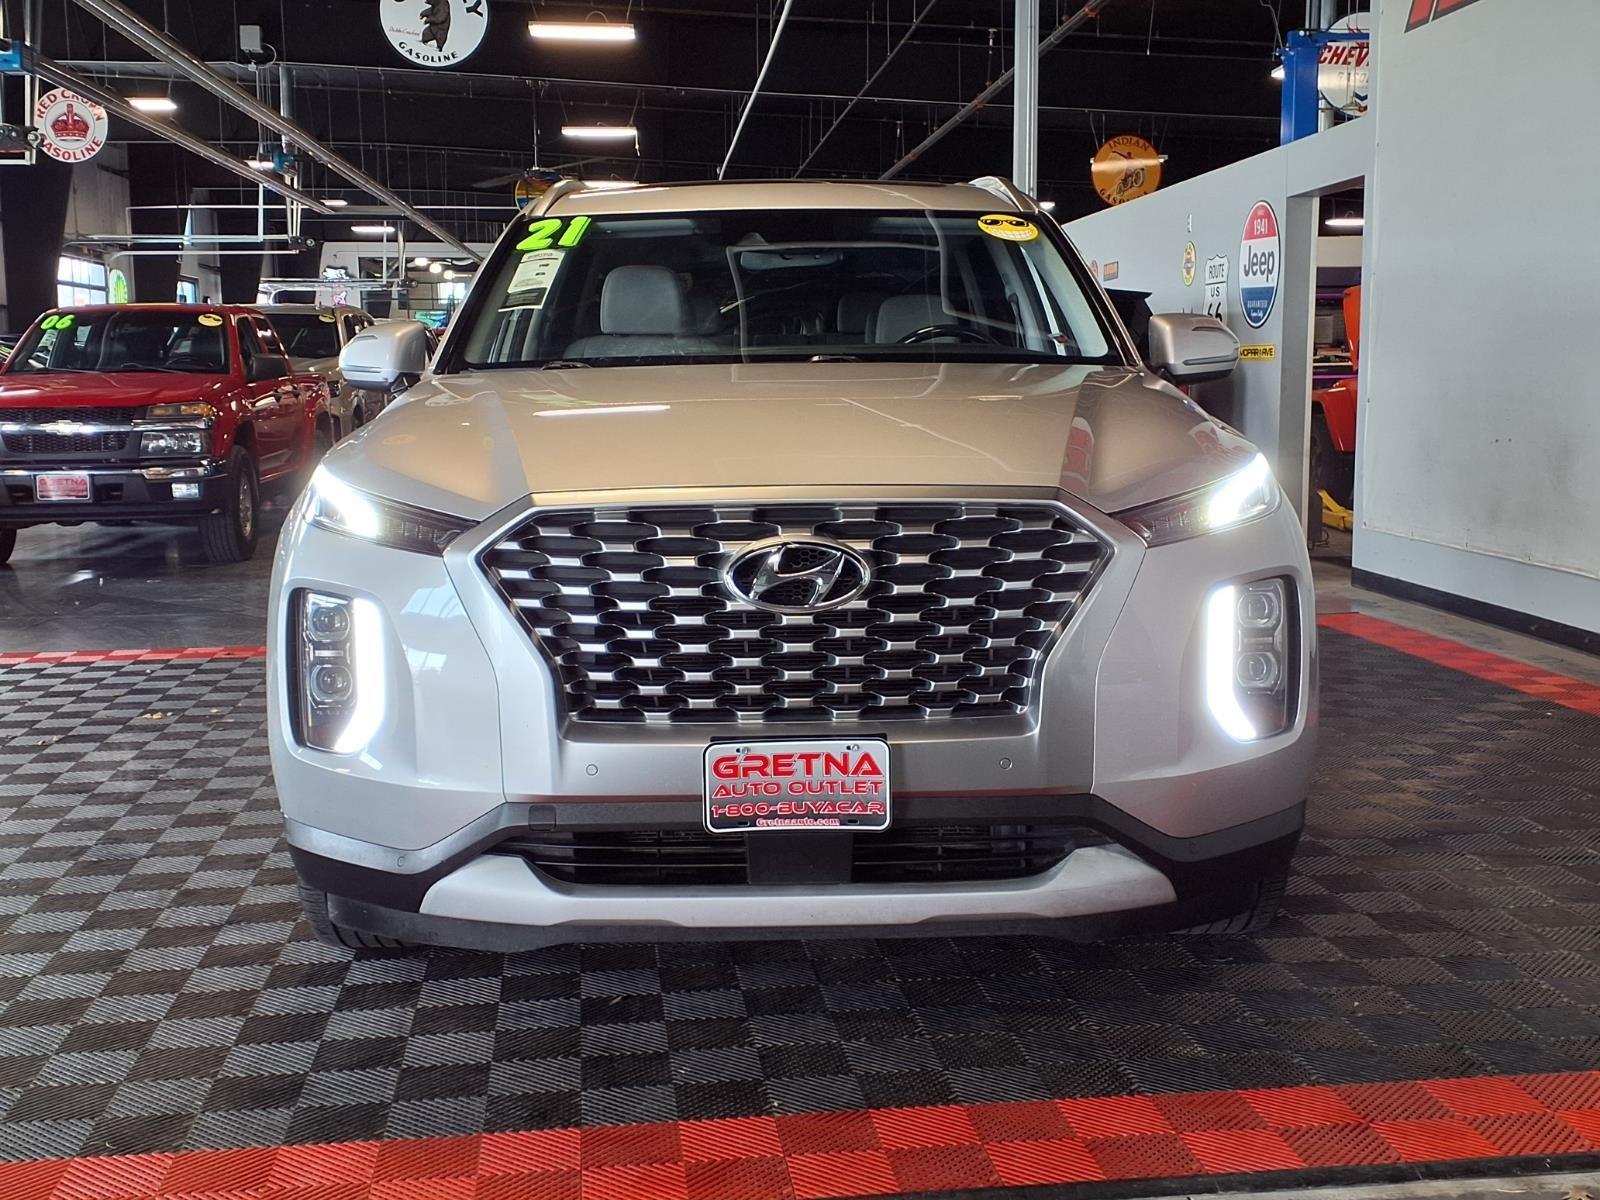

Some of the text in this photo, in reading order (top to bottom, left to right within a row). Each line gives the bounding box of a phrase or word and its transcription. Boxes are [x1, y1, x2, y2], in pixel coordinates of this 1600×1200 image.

[398, 42, 458, 63] GASOLINE
[1317, 44, 1369, 67] CHEV
[37, 93, 57, 119] RED
[1108, 137, 1150, 152] INDIAN
[516, 216, 592, 250] 21
[1253, 217, 1268, 236] 1941
[1208, 263, 1225, 280] ROUTE
[1243, 245, 1275, 283] Jeep
[1210, 286, 1221, 298] US
[40, 314, 75, 330] 06
[712, 752, 884, 780] GRETNA
[711, 780, 885, 798] AUTO OUTLET
[711, 801, 885, 818] 1-800-BUYACAR
